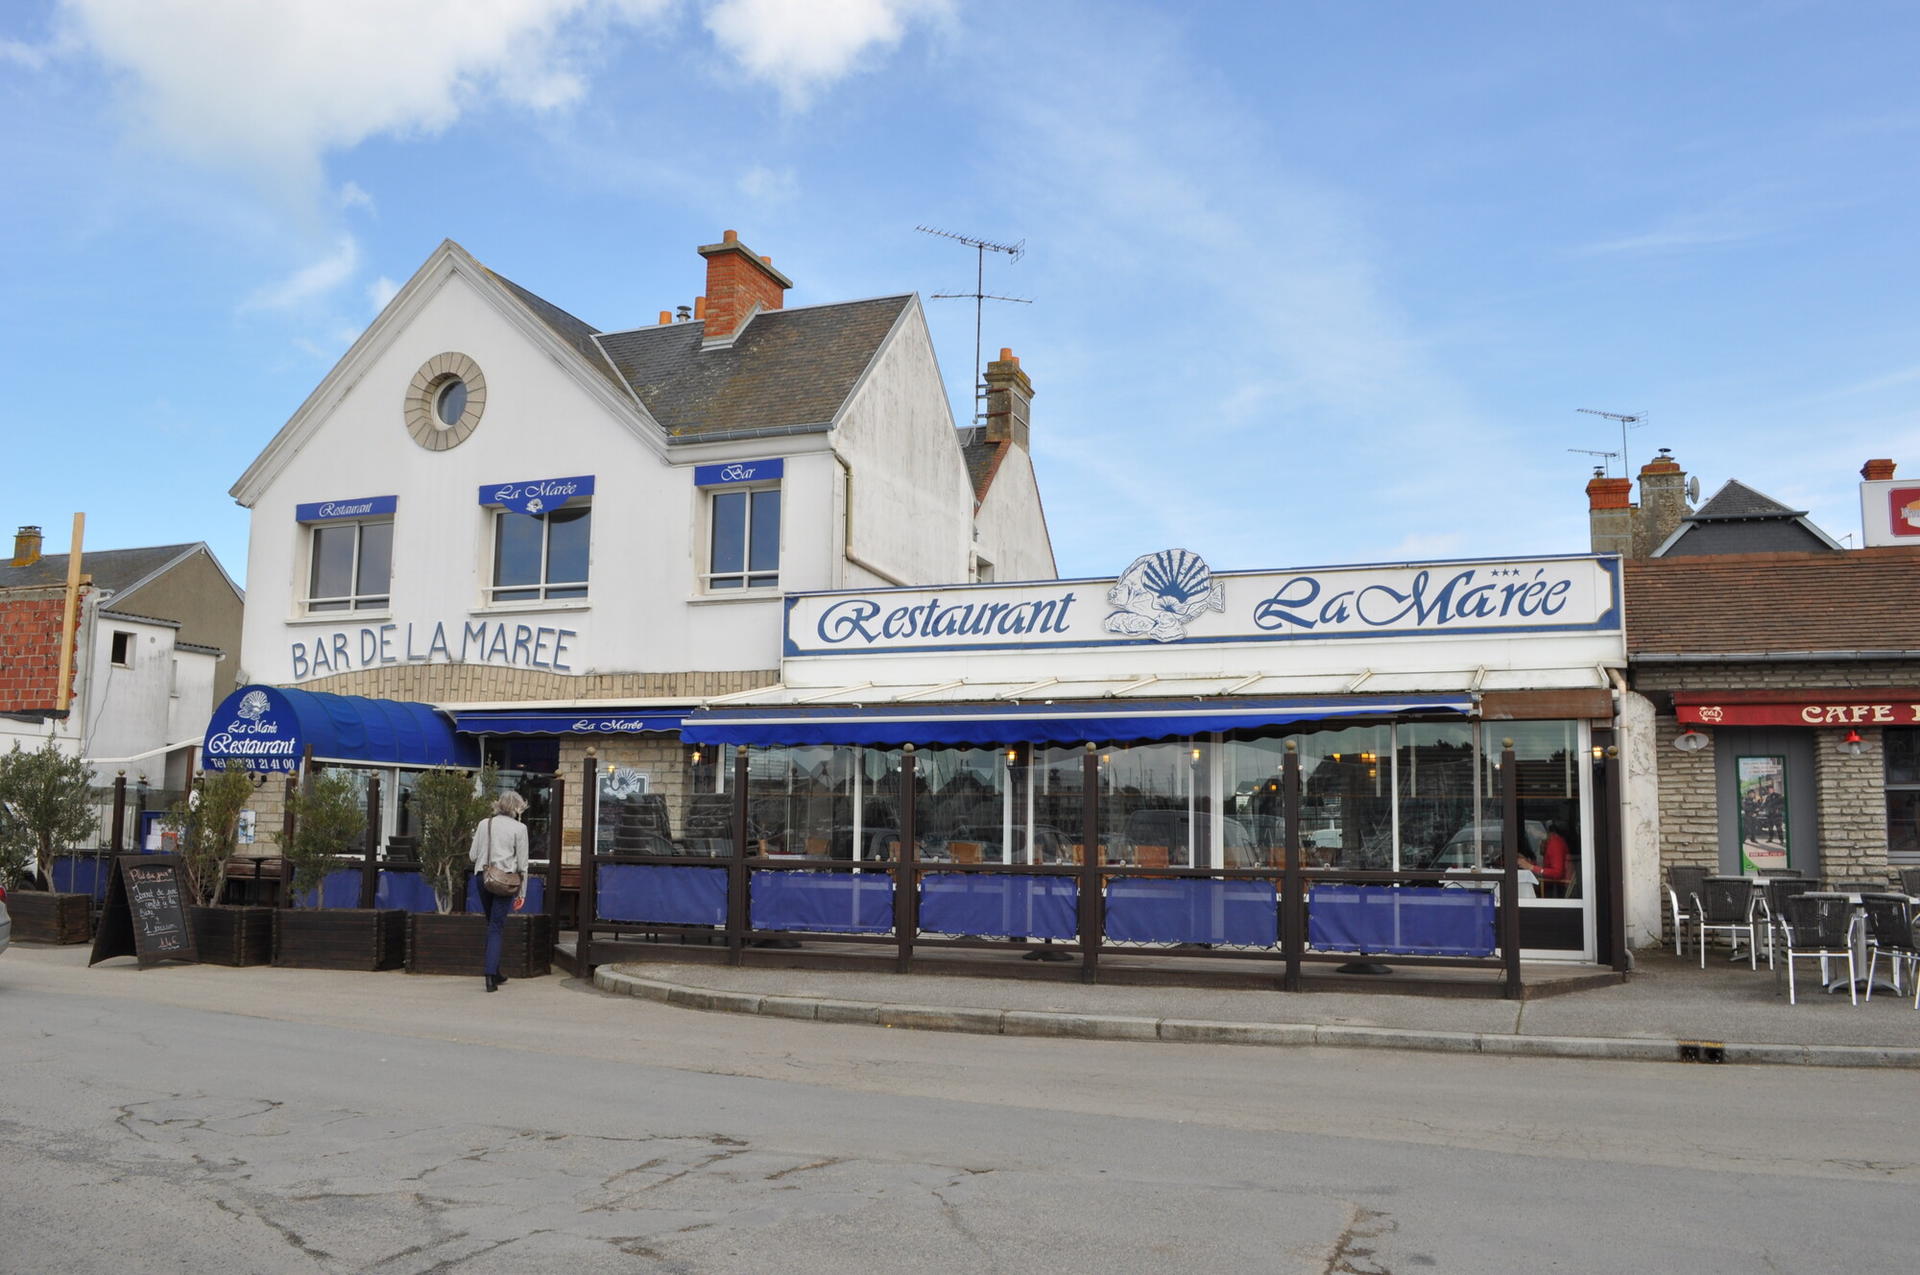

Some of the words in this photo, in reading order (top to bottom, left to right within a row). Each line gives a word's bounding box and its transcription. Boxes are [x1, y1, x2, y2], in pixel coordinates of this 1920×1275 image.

[721, 464, 756, 481] Bar
[495, 485, 520, 500] La
[525, 481, 577, 498] Marée
[319, 502, 372, 517] Restaurant
[1253, 576, 1356, 631] La
[1356, 567, 1571, 627] Marée
[817, 593, 1077, 644] Restaurant
[292, 632, 352, 680] BAR
[361, 623, 398, 667] DE
[407, 621, 450, 661] LA
[462, 621, 577, 671] MAREE
[1801, 705, 1895, 723] CAFE
[229, 720, 247, 734] La
[572, 719, 595, 730] La
[600, 719, 643, 731] Marée
[208, 733, 296, 754] Restaurant
[245, 759, 256, 769] 31
[258, 759, 269, 769] 21
[270, 759, 281, 769] 41
[282, 759, 295, 770] 00
